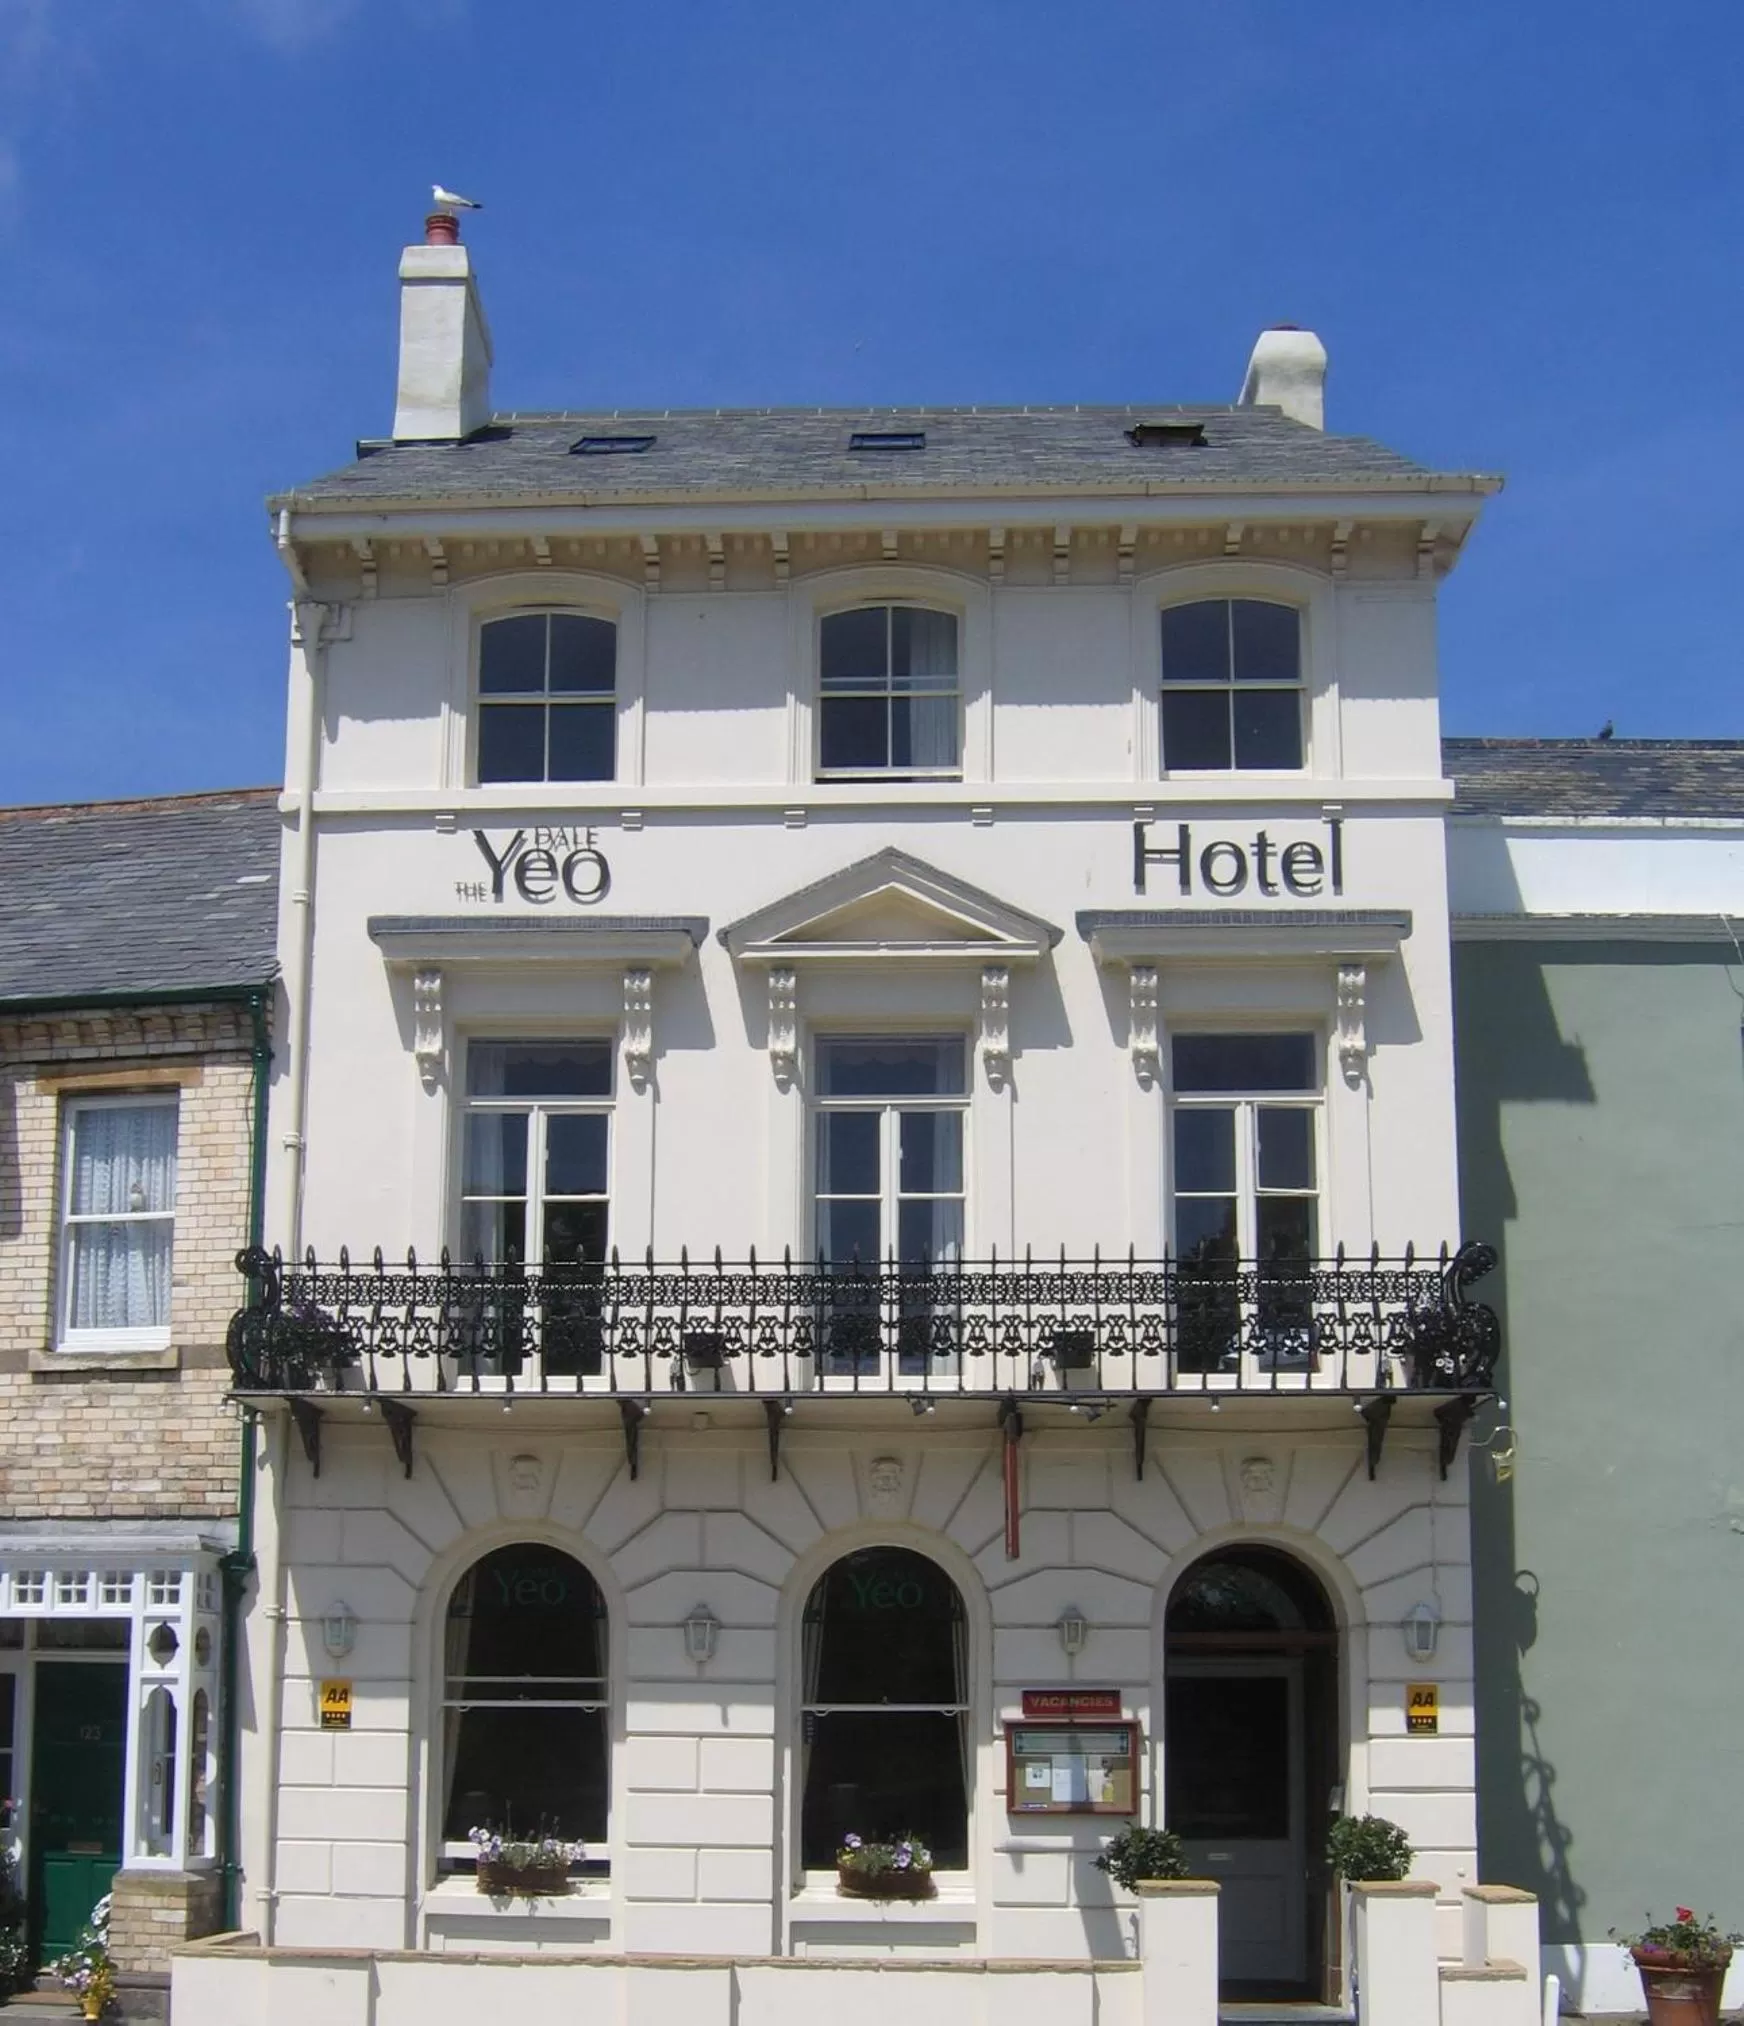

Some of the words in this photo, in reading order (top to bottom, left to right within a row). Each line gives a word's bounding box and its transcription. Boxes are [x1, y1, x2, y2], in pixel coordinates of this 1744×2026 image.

[534, 826, 599, 848] DALE
[454, 882, 487, 900] THE
[473, 829, 609, 901] Yeo
[1133, 819, 1343, 893] Hotel
[492, 1568, 568, 1606] Yeo
[847, 1571, 924, 1608] Yeo
[324, 1688, 349, 1703] AA
[1030, 1695, 1114, 1707] VACANCIES
[1411, 1692, 1434, 1707] AA
